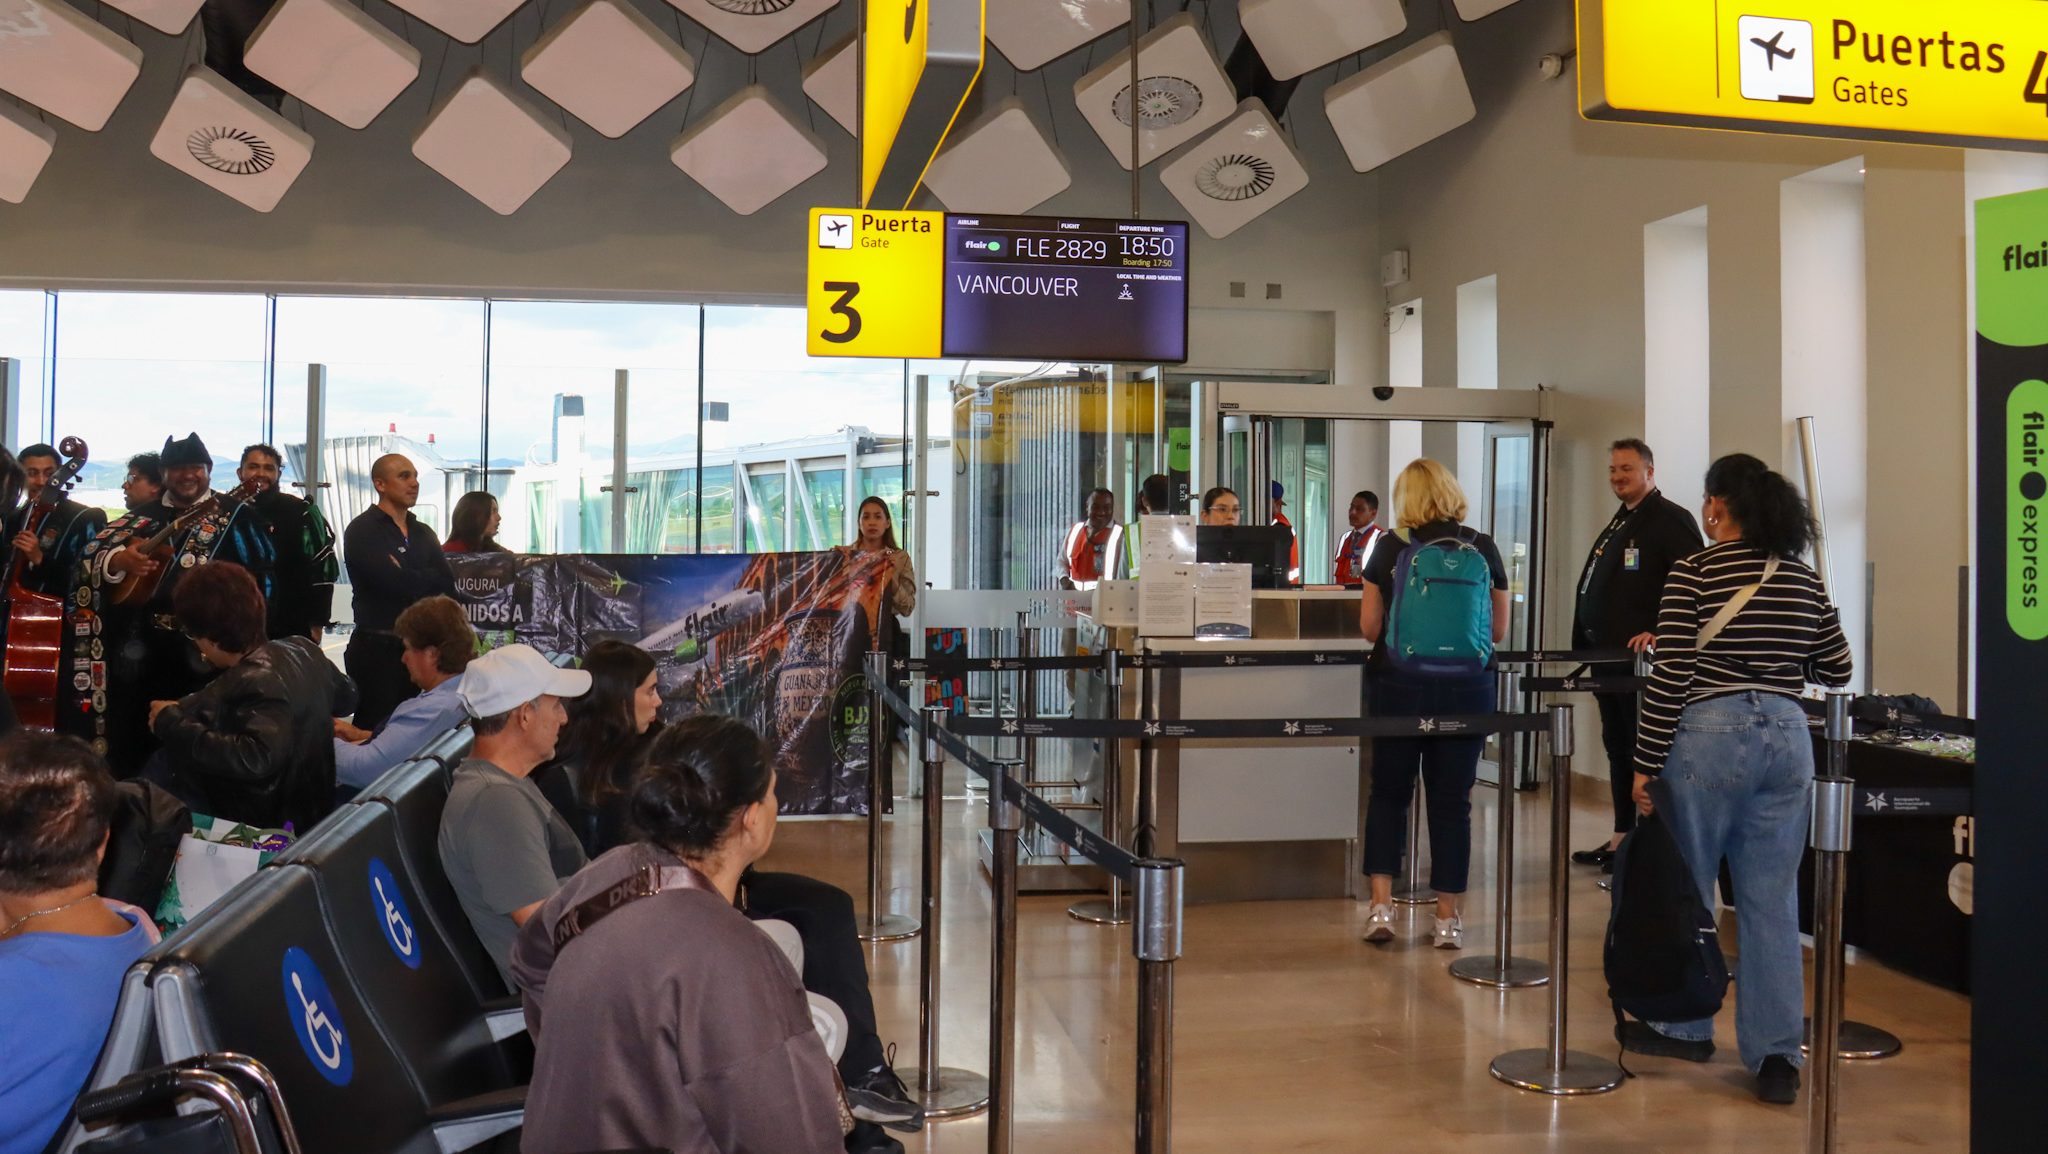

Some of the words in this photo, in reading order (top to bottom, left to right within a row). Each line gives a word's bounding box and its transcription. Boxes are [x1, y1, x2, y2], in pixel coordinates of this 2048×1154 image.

[1833, 19, 2005, 73] Puertas
[1833, 76, 1908, 107] Gates
[862, 214, 931, 233] Puerta
[861, 236, 889, 248] Gate
[965, 240, 987, 249] flair
[1016, 238, 1050, 258] FLE
[1055, 239, 1107, 260] 2829
[1119, 235, 1174, 257] 18:50
[1122, 258, 1151, 268] Boarding
[1153, 259, 1173, 268] 17:50
[2003, 240, 2048, 272] flai
[957, 274, 1079, 297] VANCOUVER
[820, 281, 862, 343] 3
[2023, 411, 2045, 467] flair
[1179, 483, 1188, 502] Exit
[2018, 505, 2038, 608] express
[455, 578, 502, 592] UGURAL
[461, 603, 510, 622] NIDOS
[512, 604, 523, 622] A
[1953, 815, 1975, 858] fl
